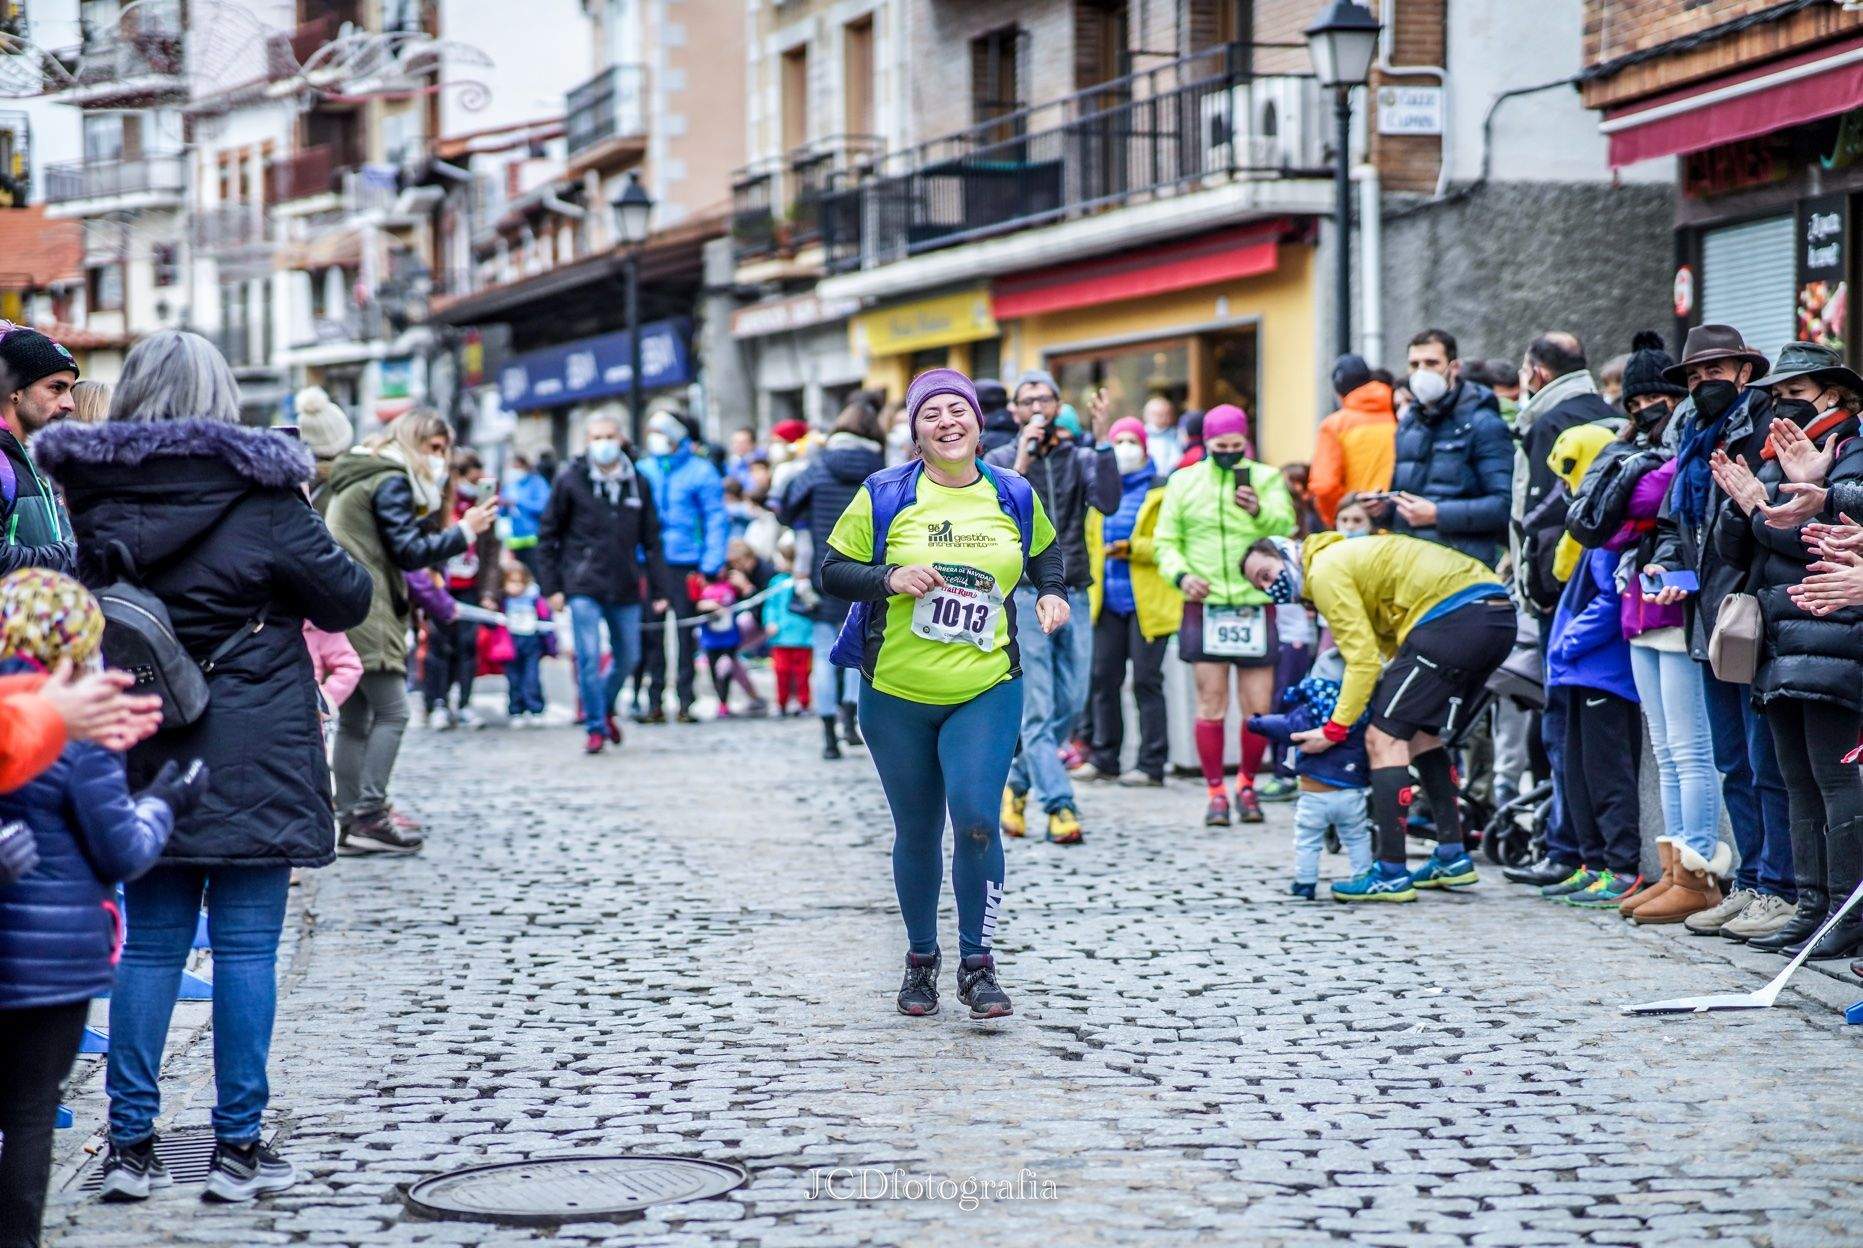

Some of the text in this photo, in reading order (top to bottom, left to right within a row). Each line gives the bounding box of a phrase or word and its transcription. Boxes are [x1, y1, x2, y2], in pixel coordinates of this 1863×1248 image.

[954, 533, 989, 543] gestión
[966, 569, 994, 582] NAVIDAD
[931, 596, 989, 634] 1013
[1218, 626, 1251, 643] 953
[981, 880, 1003, 947] NIKE
